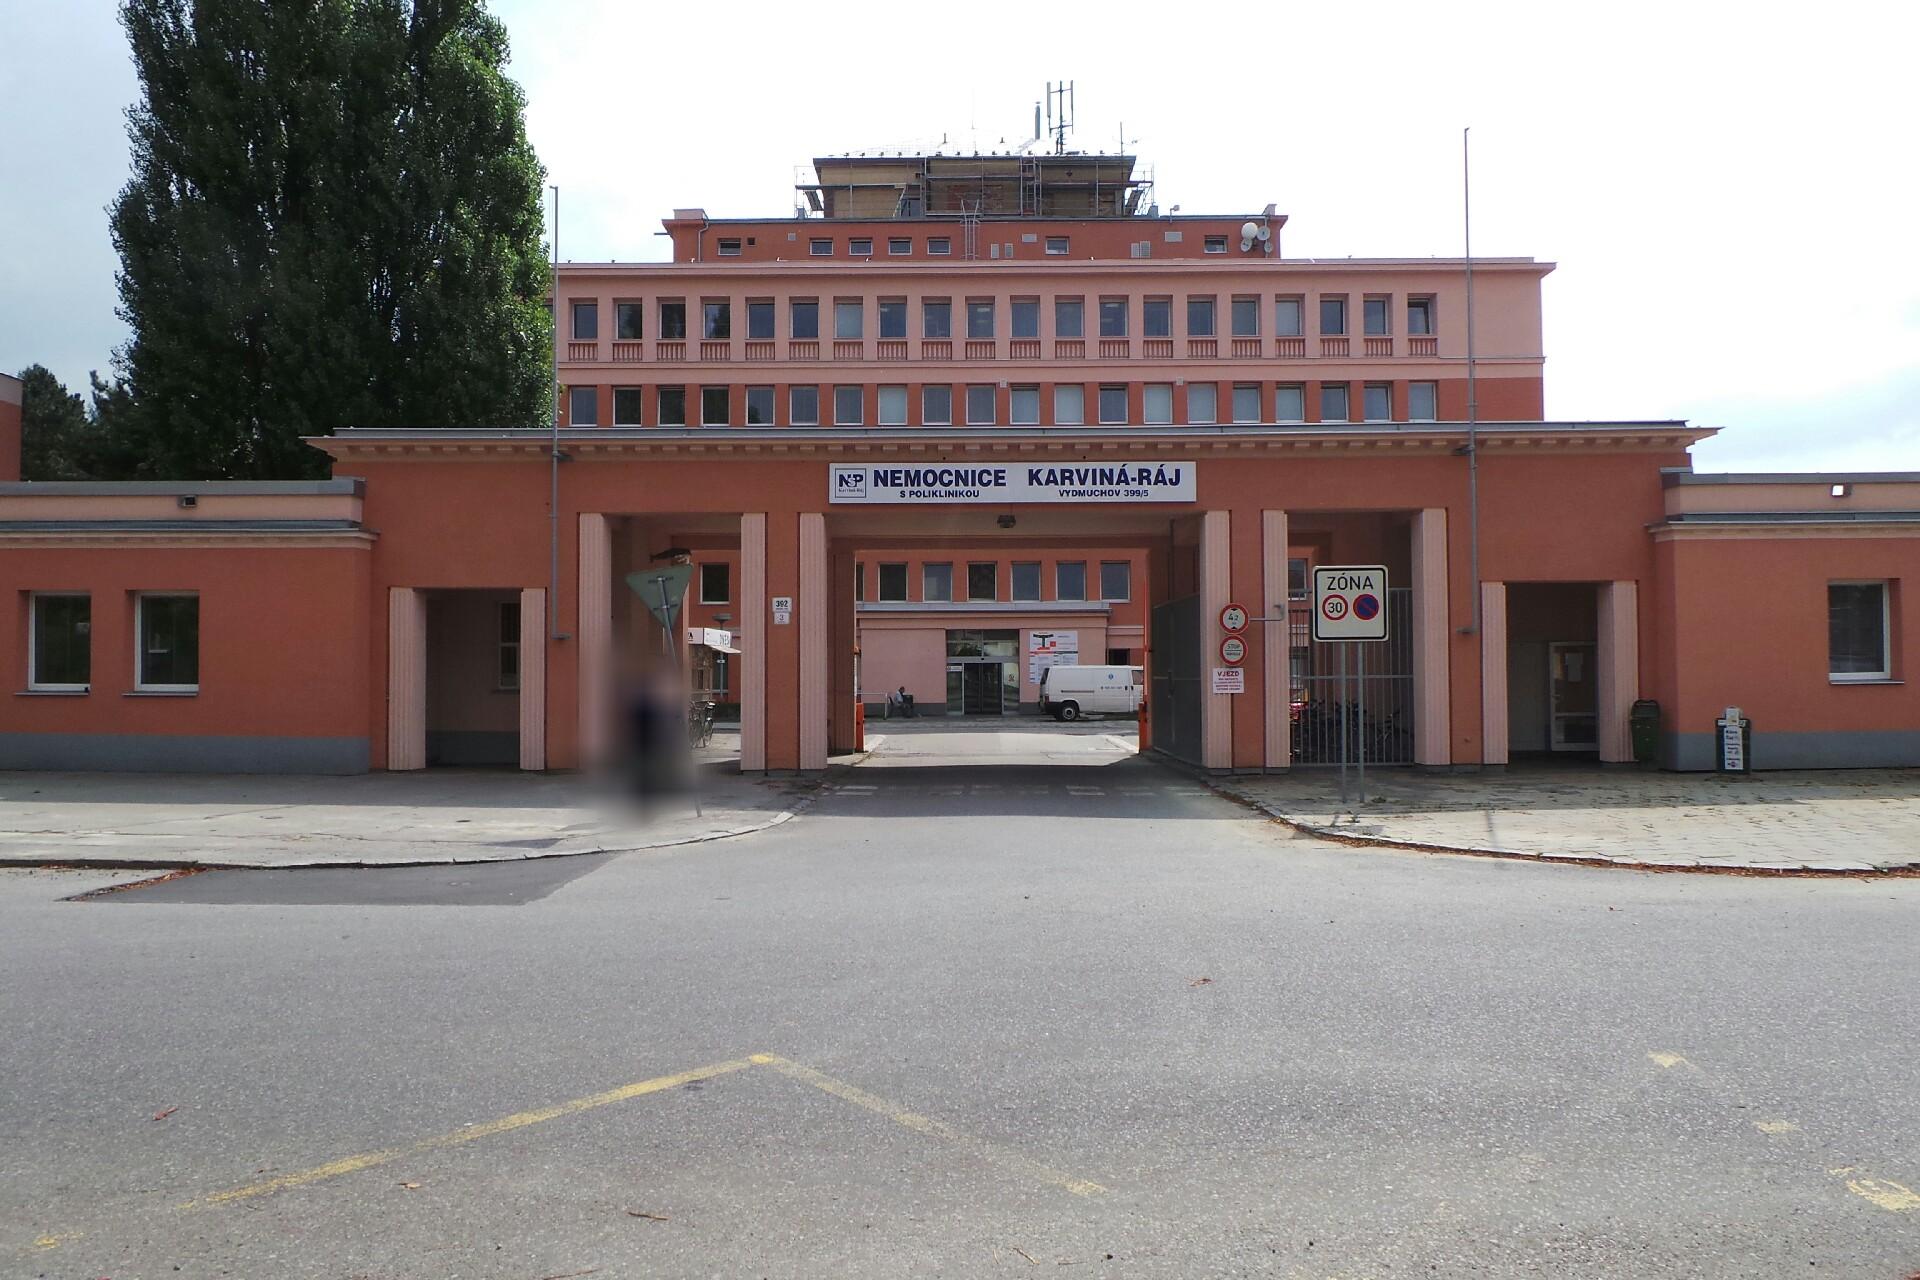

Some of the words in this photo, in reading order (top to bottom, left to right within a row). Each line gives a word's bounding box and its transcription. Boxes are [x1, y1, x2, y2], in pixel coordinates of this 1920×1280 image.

[873, 469, 1006, 487] NEMOCNICE
[1028, 463, 1181, 487] KARVINÁ-RÁJ
[899, 490, 906, 498] S
[909, 490, 980, 498] POLIKLINIKOU
[1059, 489, 1121, 497] VYDMUCHOV
[1124, 489, 1149, 498] 399/5
[1327, 572, 1374, 591] ZÓNA
[1327, 602, 1343, 614] 30
